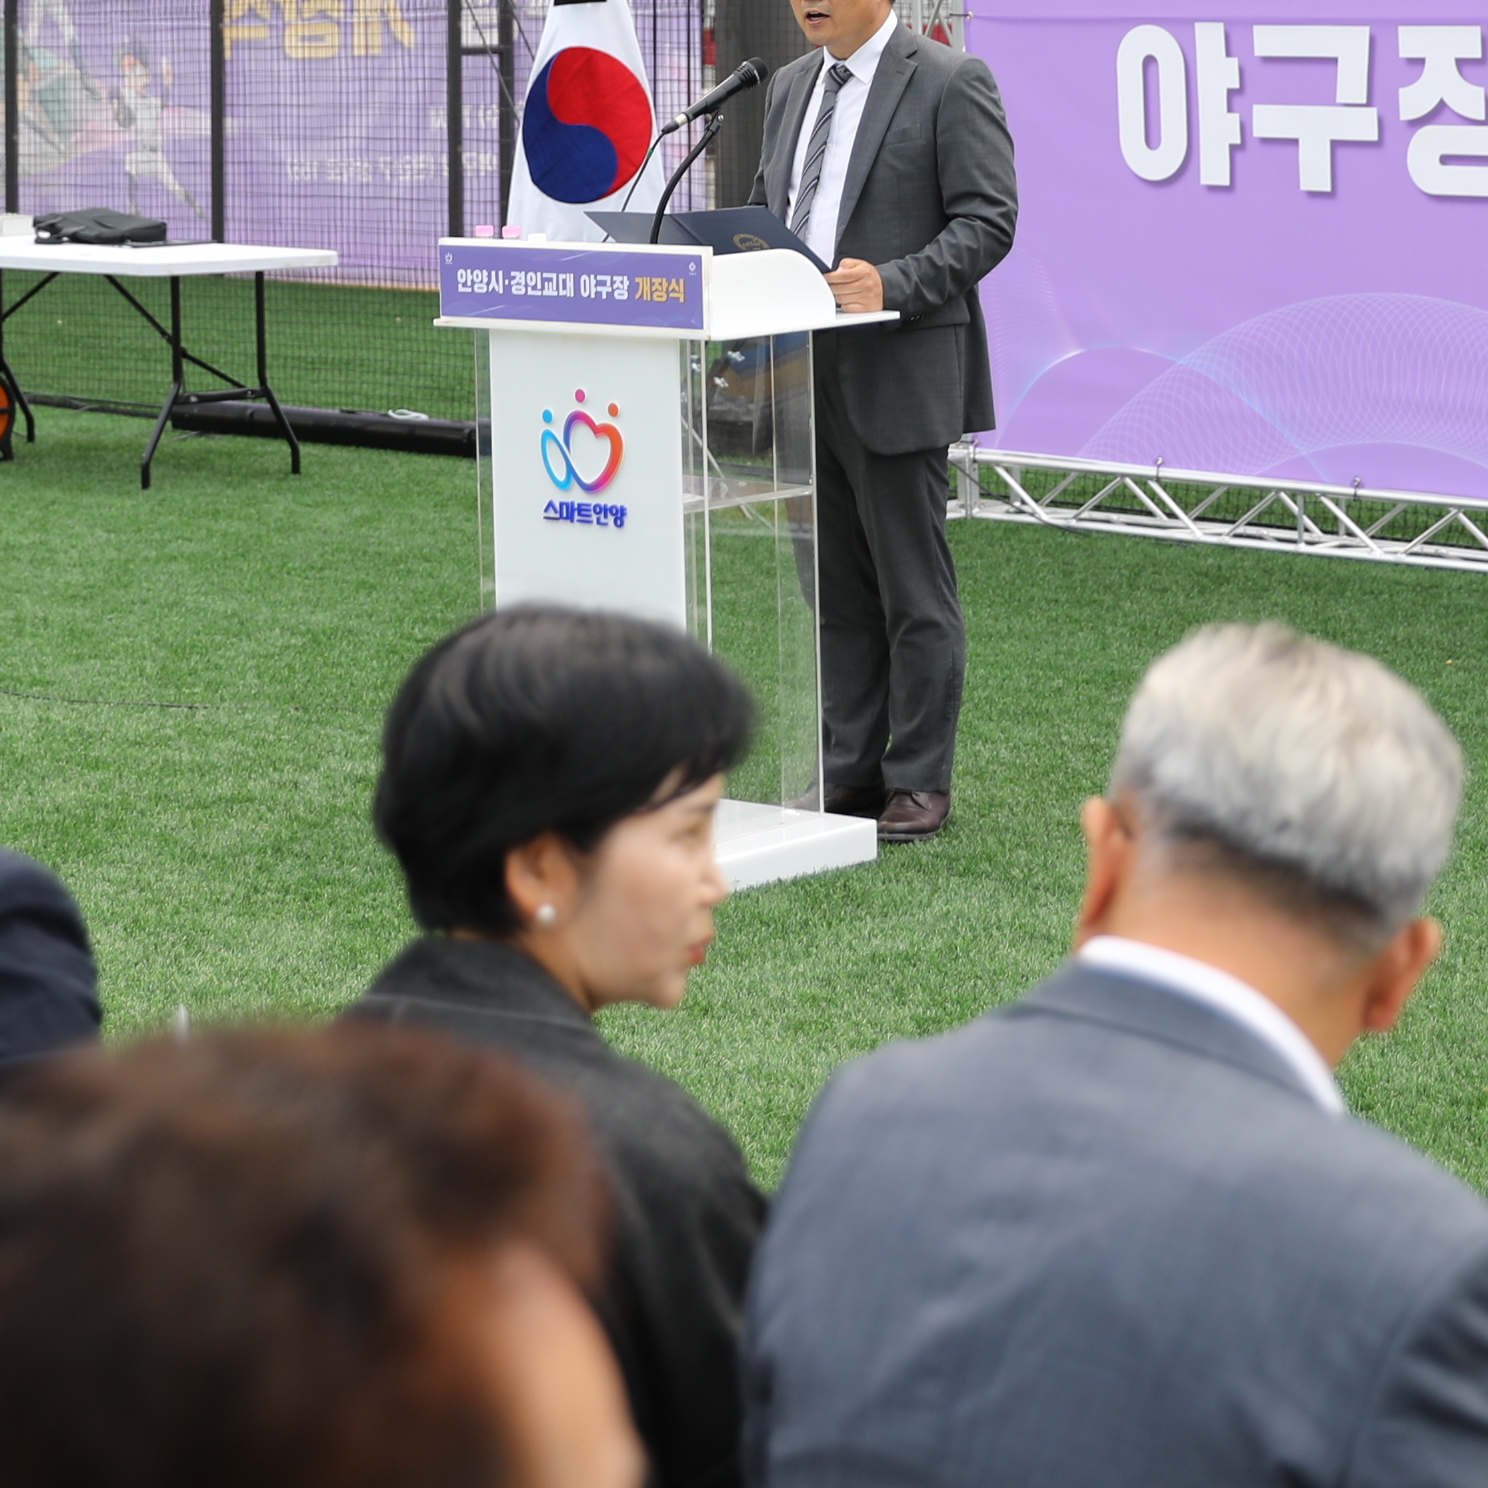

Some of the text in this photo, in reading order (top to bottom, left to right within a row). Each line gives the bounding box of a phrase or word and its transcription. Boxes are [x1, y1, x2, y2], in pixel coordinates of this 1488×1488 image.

[456, 268, 686, 303] 안양시·경인교대 야구장 개장식
[543, 499, 627, 528] 스마트안양
